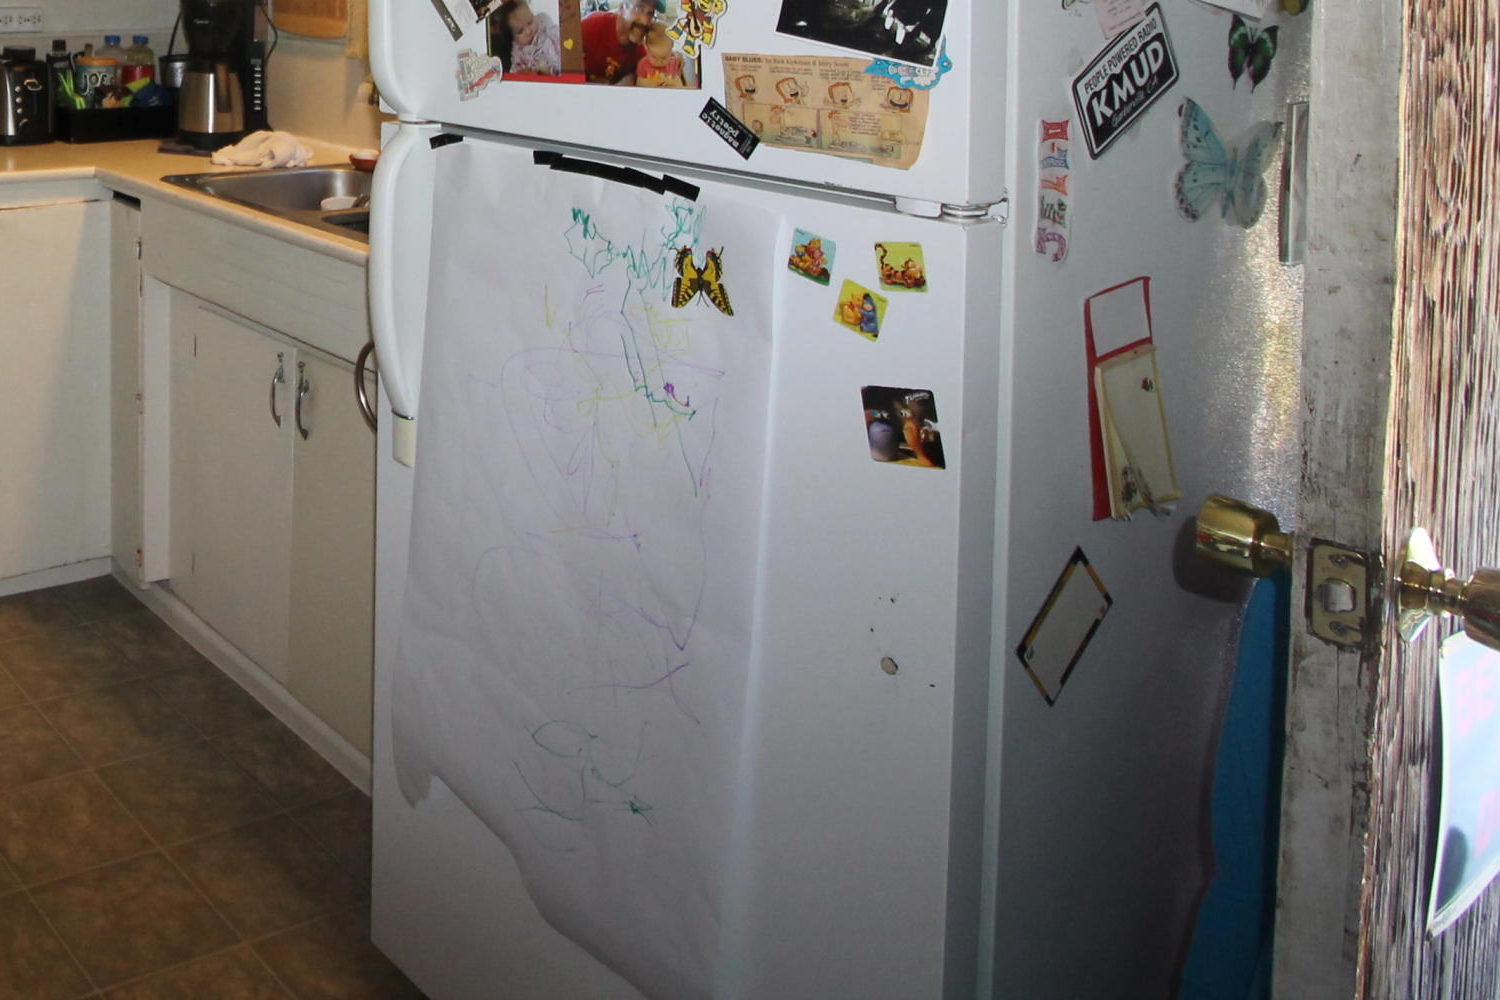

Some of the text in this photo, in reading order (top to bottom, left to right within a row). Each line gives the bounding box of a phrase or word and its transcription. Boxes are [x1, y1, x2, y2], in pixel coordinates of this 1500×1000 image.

[1084, 17, 1158, 93] PEOPLE POWERED RADIO
[1090, 40, 1165, 126] KMUD
[711, 110, 740, 138] poetry
